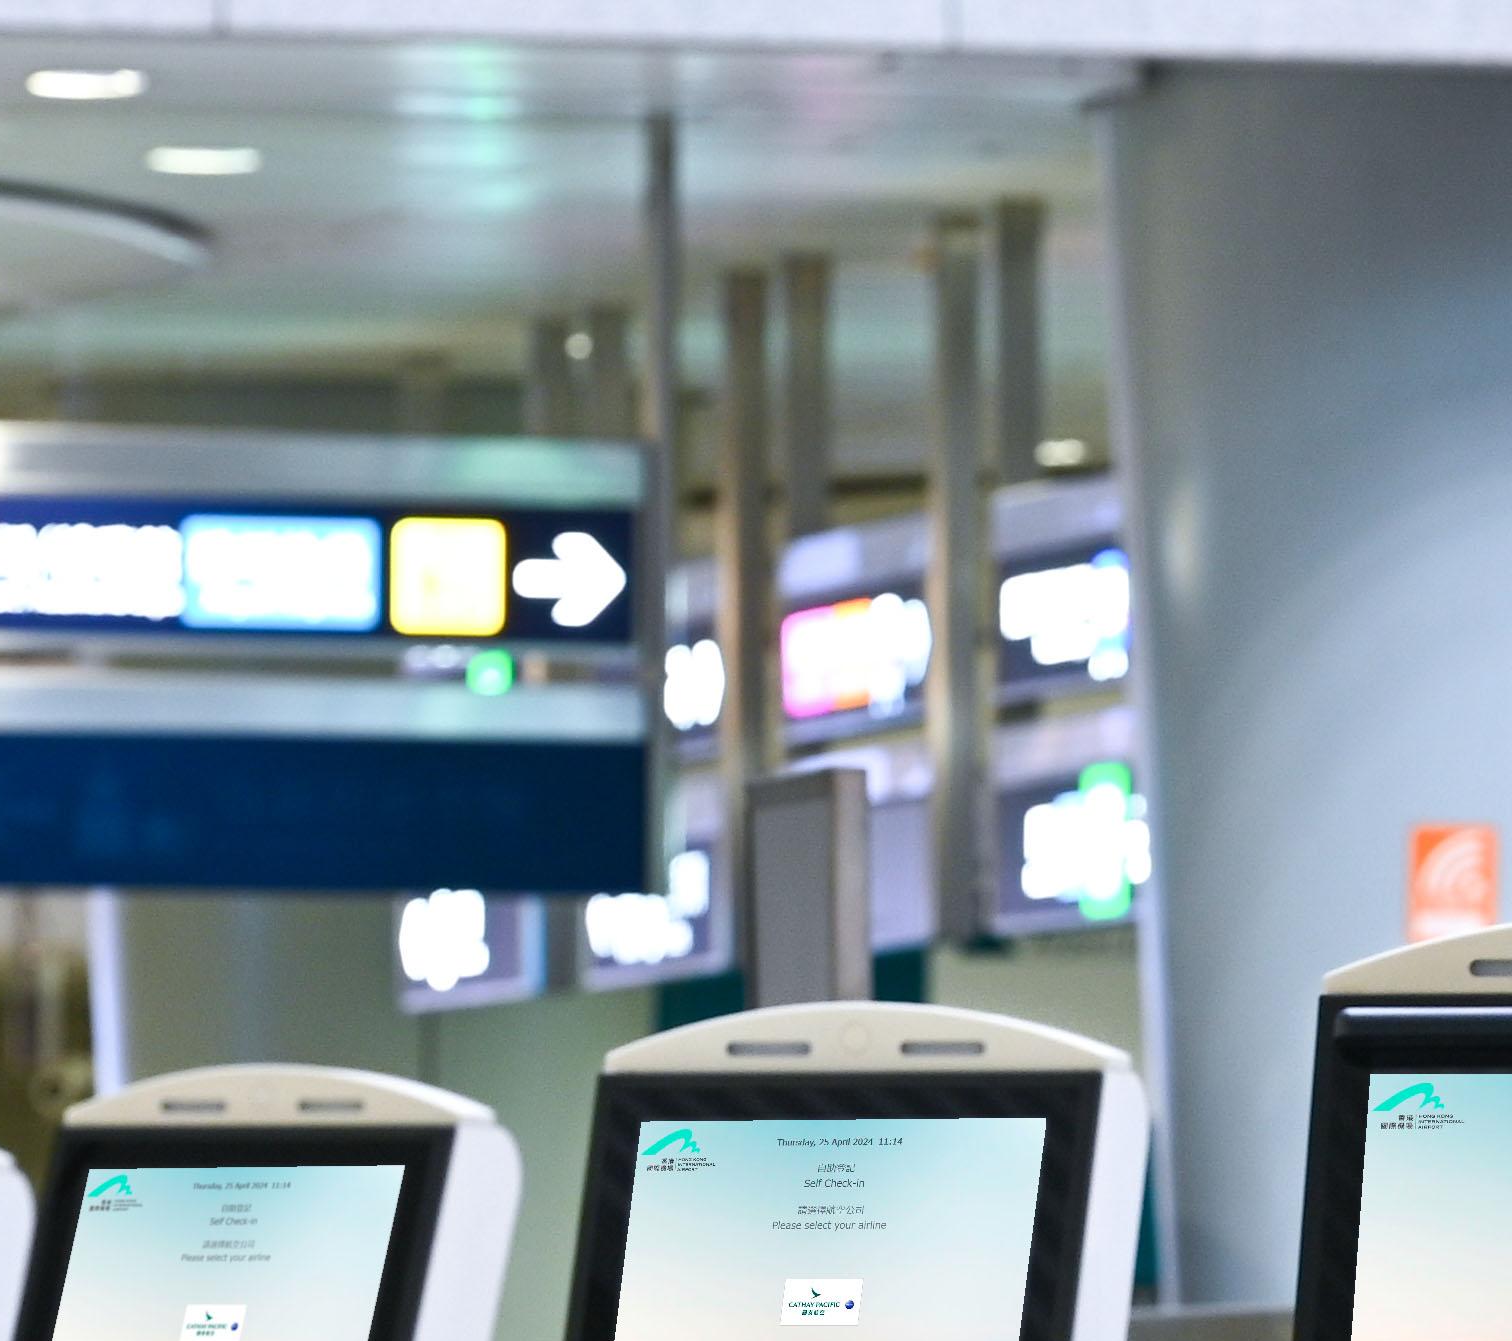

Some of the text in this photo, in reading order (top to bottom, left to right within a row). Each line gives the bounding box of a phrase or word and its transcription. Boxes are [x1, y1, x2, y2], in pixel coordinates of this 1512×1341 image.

[831, 1137, 851, 1148] April
[852, 1136, 873, 1146] 2024
[878, 1136, 903, 1146] 11:14
[803, 1178, 865, 1189] Self Check-in
[772, 1220, 887, 1232] Please select your airline
